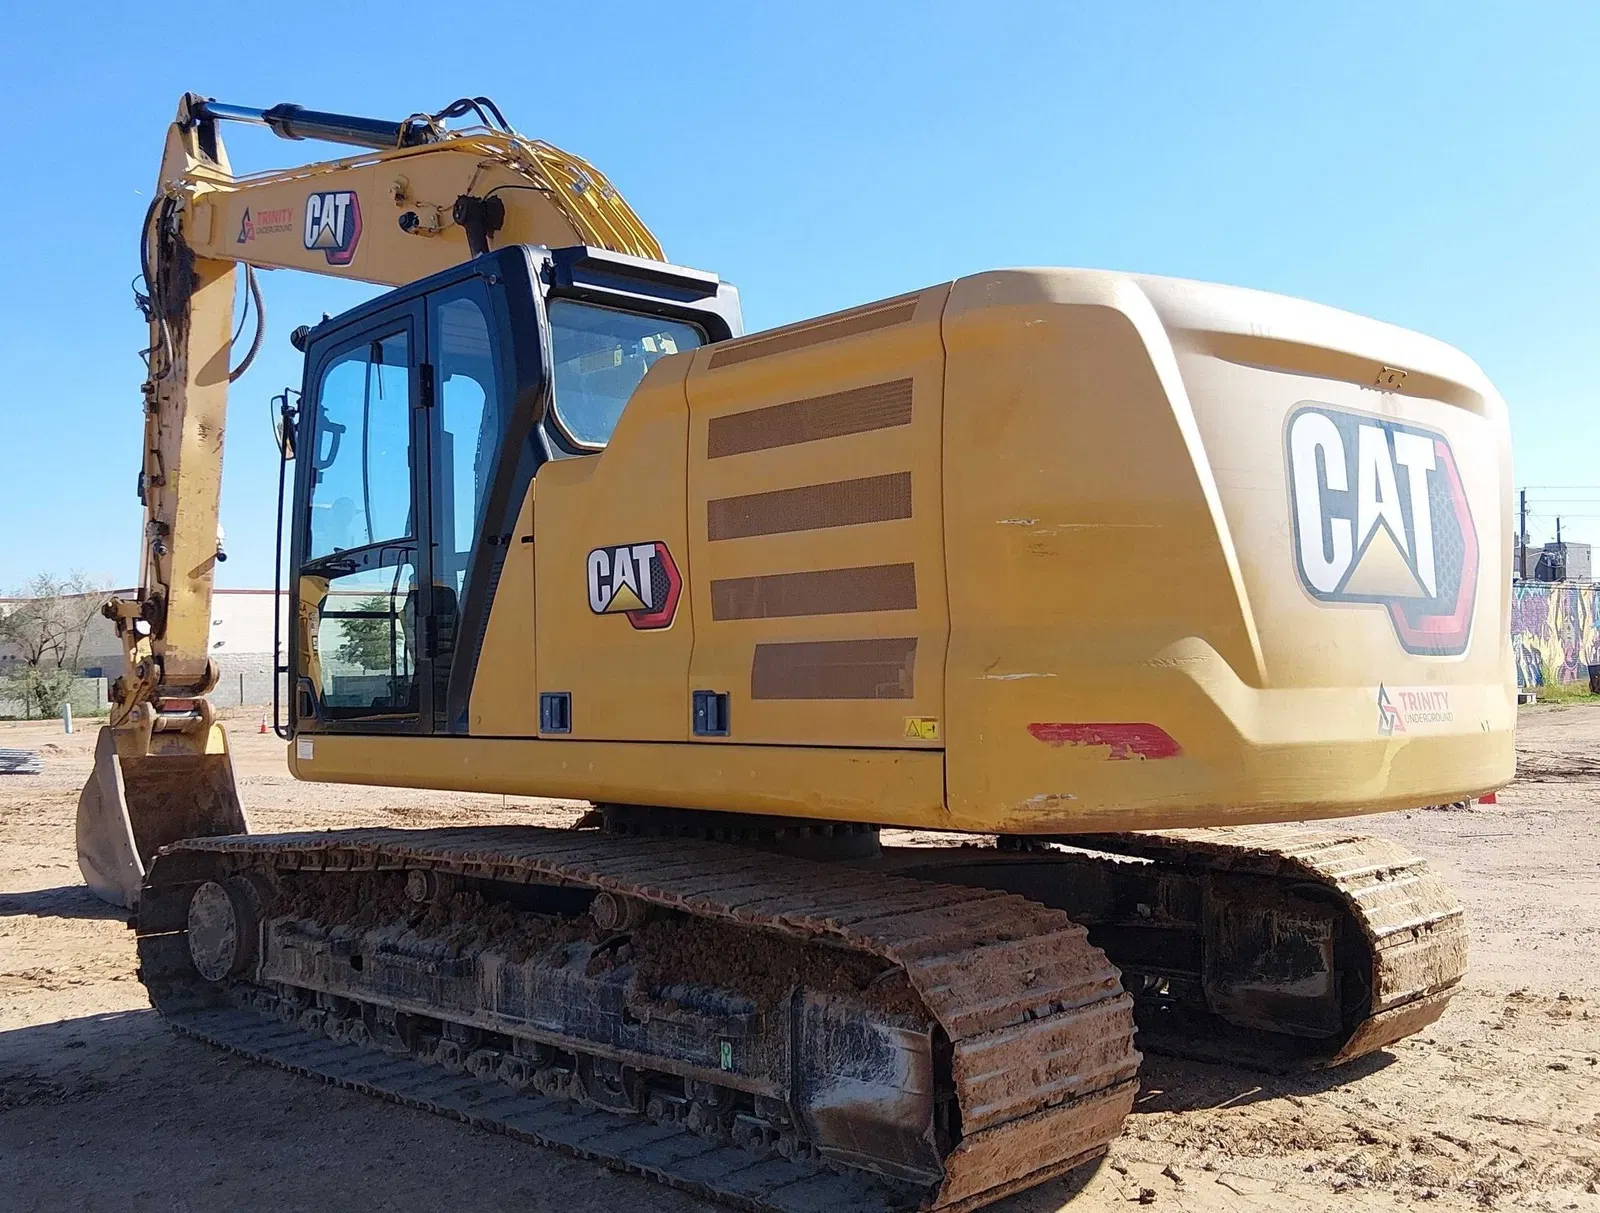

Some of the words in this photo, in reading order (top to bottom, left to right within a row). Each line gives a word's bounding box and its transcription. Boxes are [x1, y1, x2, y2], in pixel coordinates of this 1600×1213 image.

[257, 208, 294, 225] TRINITY
[305, 192, 351, 248] CAT
[1290, 412, 1437, 599] CAT
[588, 543, 656, 613] CAT
[1398, 691, 1449, 711] TRINITY
[1404, 712, 1454, 724] UNDERGROUND
